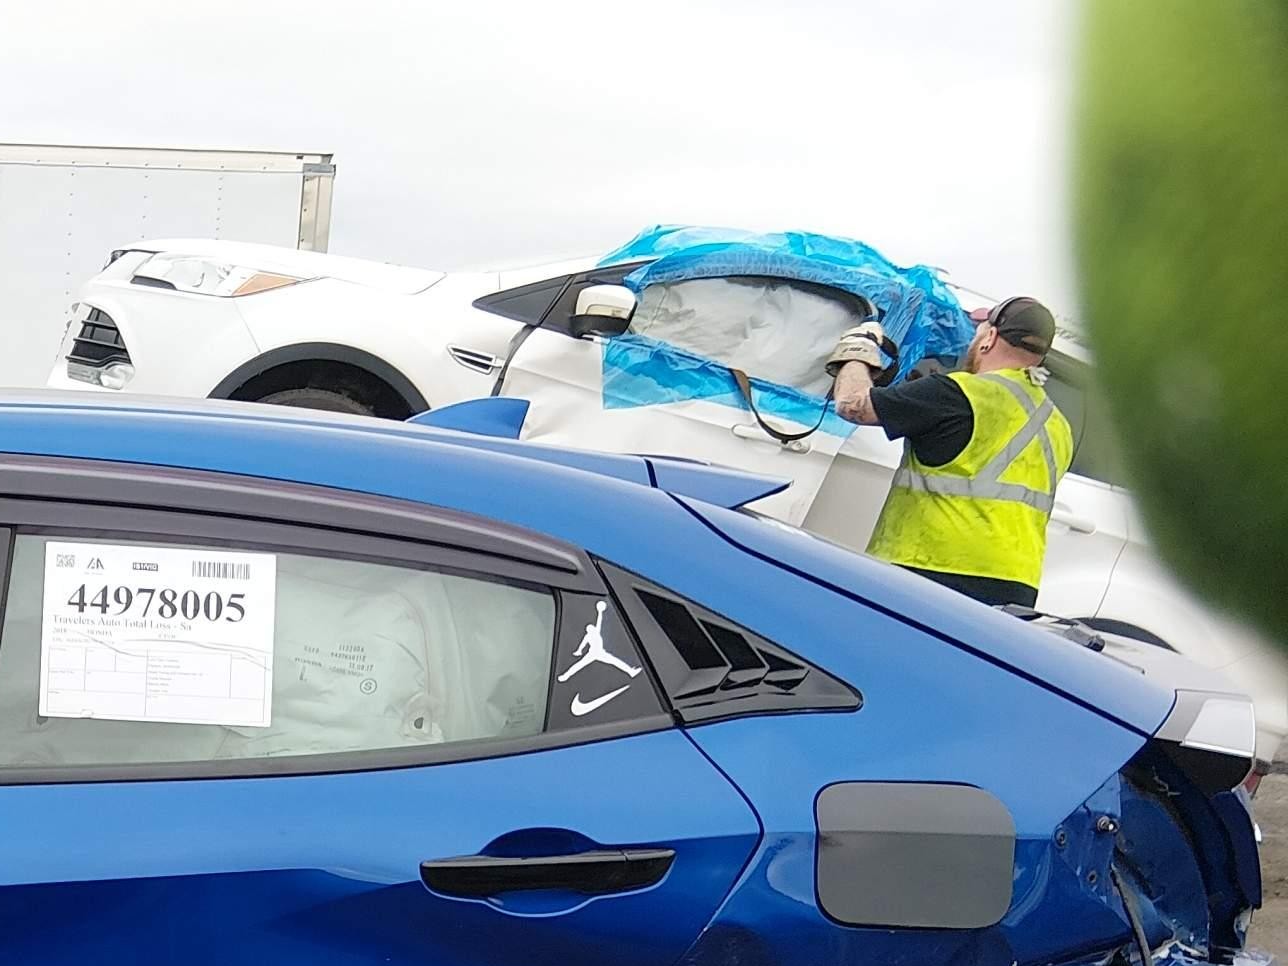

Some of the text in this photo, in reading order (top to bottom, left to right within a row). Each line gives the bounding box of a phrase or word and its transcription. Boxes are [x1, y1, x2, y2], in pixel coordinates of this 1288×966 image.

[67, 582, 246, 623] 44978005
[53, 614, 96, 626] Travelers
[98, 617, 121, 627] Auto
[124, 619, 147, 629] Total
[150, 620, 171, 630] Loss
